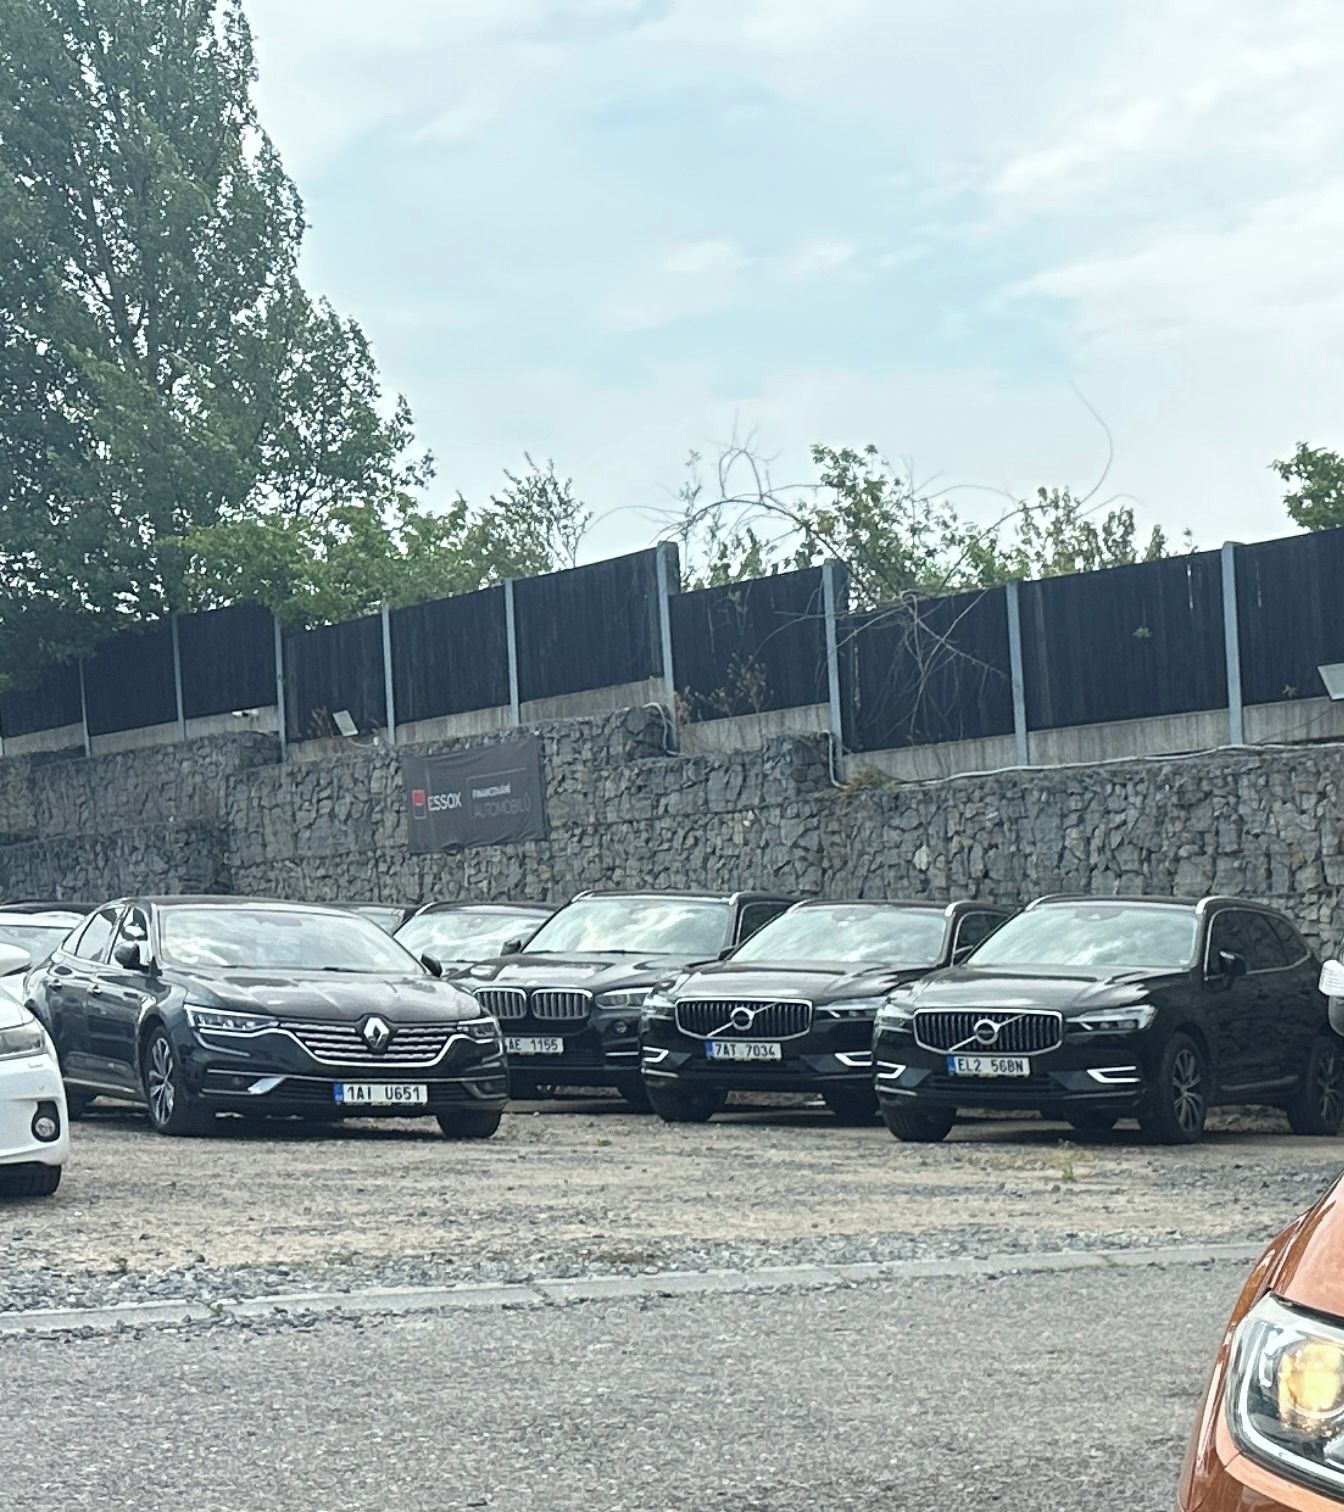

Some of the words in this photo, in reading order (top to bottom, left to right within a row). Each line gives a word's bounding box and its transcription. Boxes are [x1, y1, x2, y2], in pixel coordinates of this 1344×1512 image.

[427, 791, 462, 812] ESSOX
[505, 1038, 521, 1050] AE
[530, 1038, 558, 1050] 1155
[715, 1043, 736, 1056] 7AT
[746, 1044, 776, 1057] 7034
[957, 1058, 982, 1072] EL2
[347, 1086, 372, 1101] 1AI
[385, 1086, 420, 1101] U651
